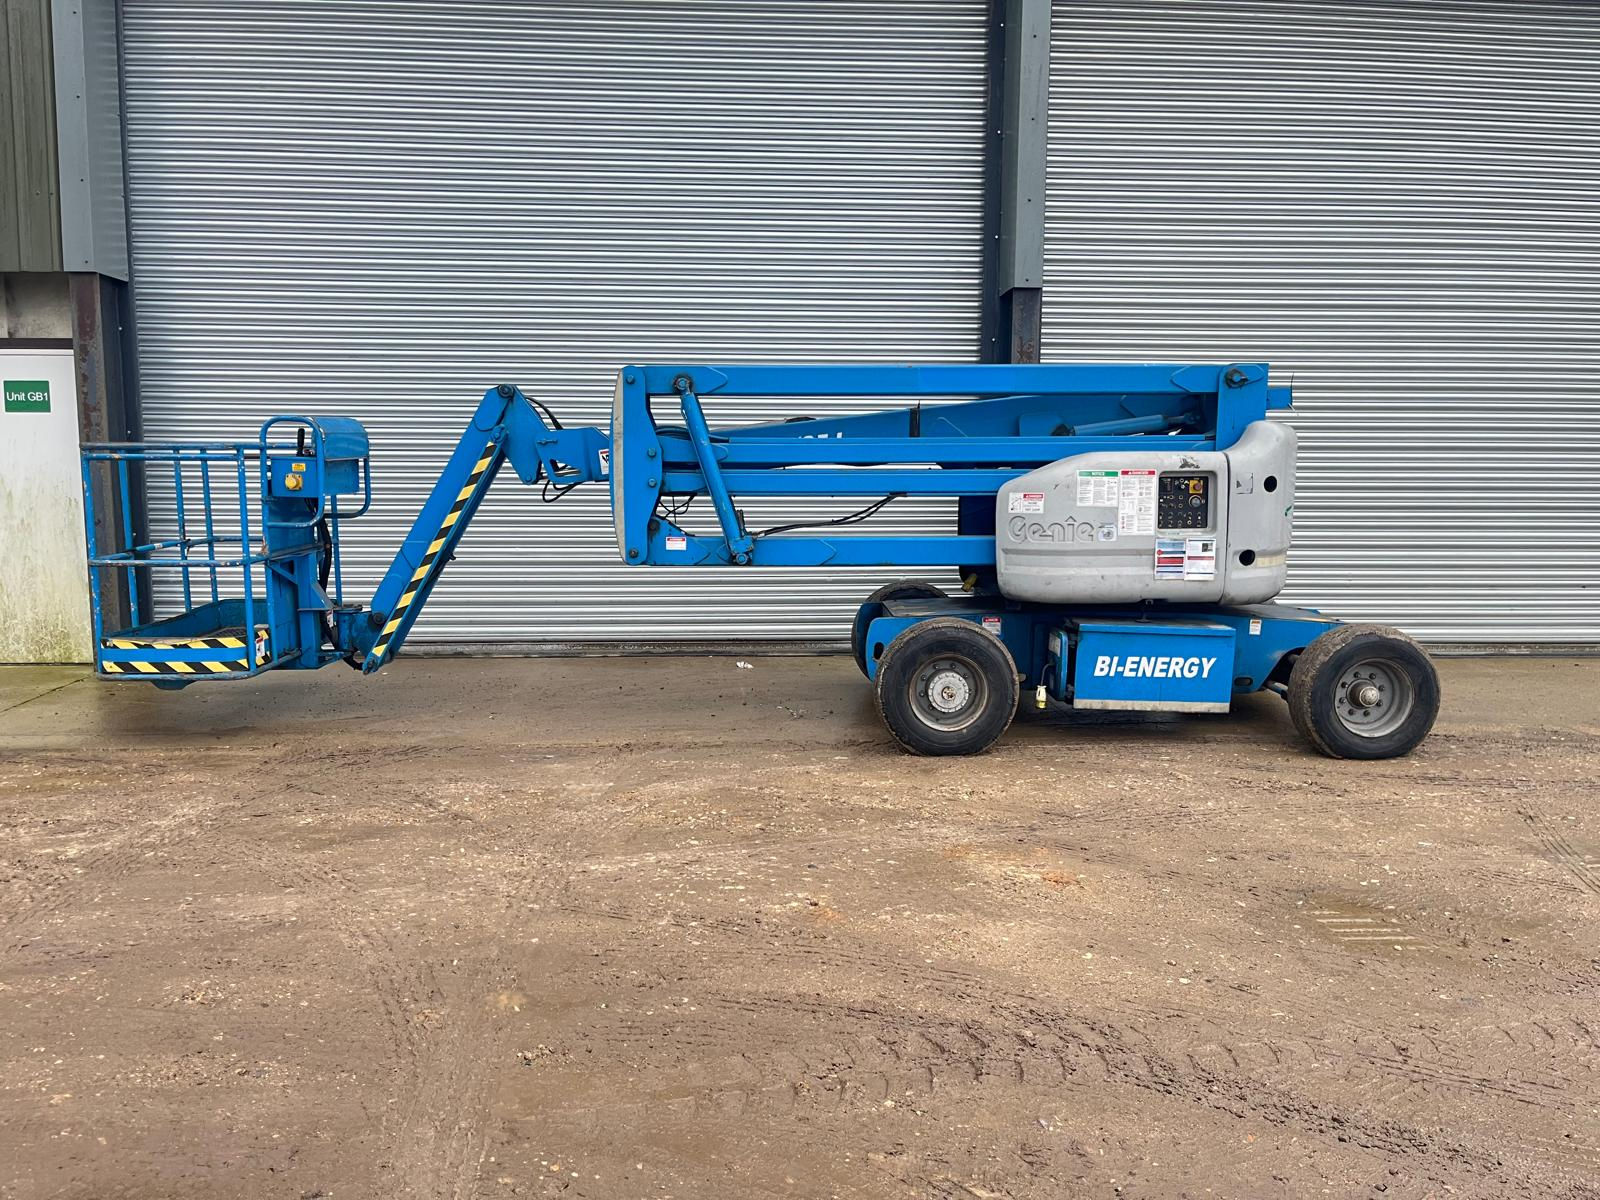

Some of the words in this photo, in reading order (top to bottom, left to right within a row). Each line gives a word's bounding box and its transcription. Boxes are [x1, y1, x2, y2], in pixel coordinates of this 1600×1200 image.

[6, 391, 26, 401] Unit
[27, 391, 48, 401] GB1
[1093, 655, 1217, 678] BI-ENERGY
